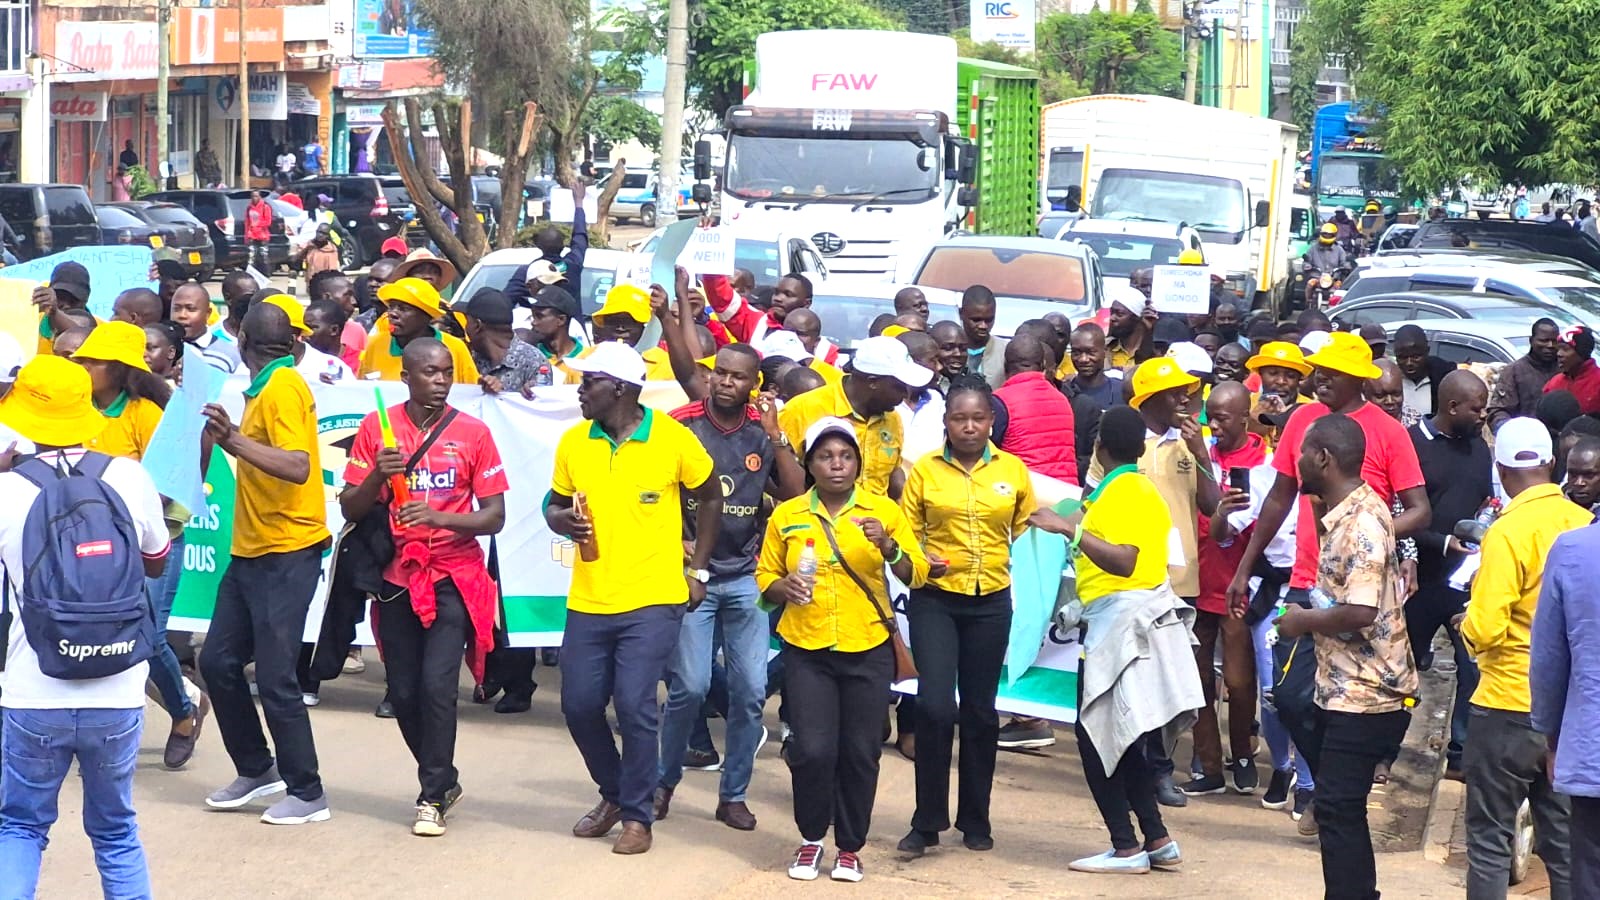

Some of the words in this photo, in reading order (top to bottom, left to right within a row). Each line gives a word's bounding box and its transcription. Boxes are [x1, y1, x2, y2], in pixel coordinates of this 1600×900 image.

[986, 3, 1011, 16] RIC
[812, 74, 878, 91] FAW
[51, 96, 97, 115] ata
[813, 112, 852, 131] FAW
[184, 503, 220, 530] ERS
[76, 543, 111, 555] Supreme
[184, 544, 216, 573] OUS
[58, 639, 136, 662] Supreme
